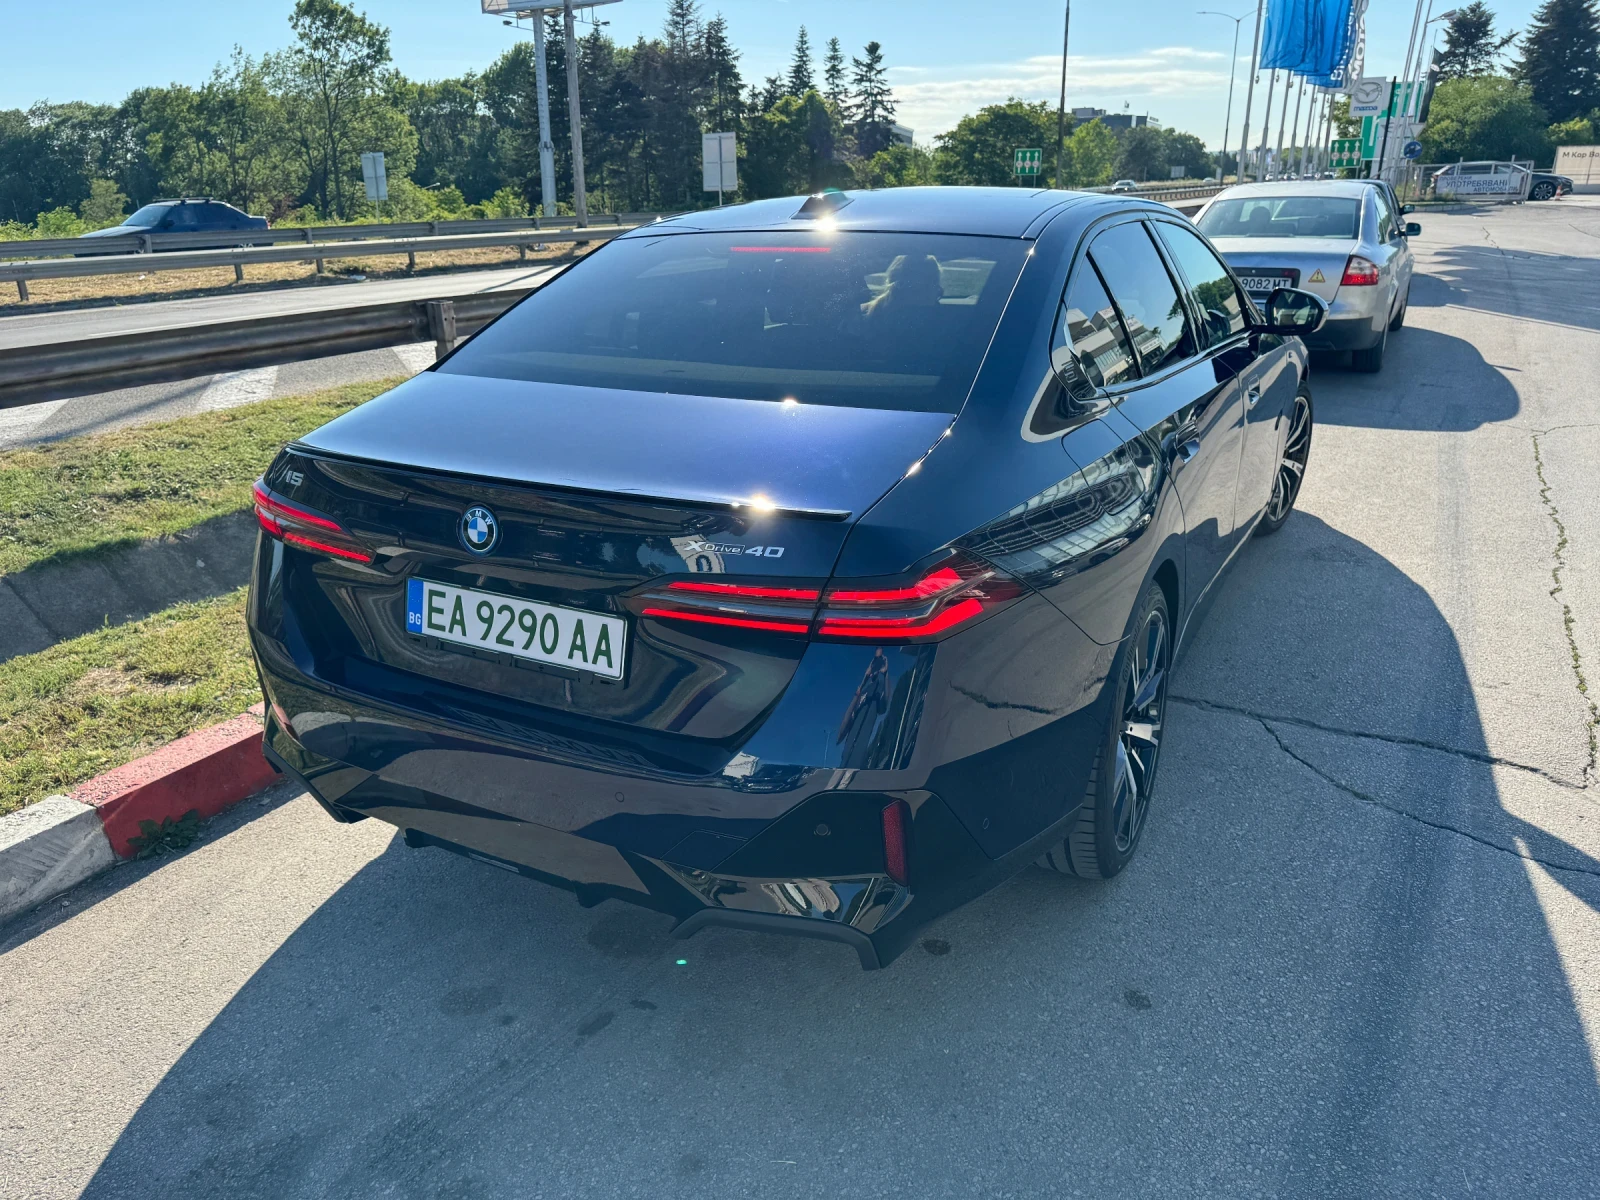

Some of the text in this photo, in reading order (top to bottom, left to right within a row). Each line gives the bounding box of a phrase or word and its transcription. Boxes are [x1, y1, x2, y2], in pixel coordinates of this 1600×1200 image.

[1242, 278, 1270, 290] 9082
[465, 509, 493, 526] BMW
[745, 546, 785, 558] 40
[408, 611, 421, 625] BG
[427, 588, 613, 668] EA 9290 AA
